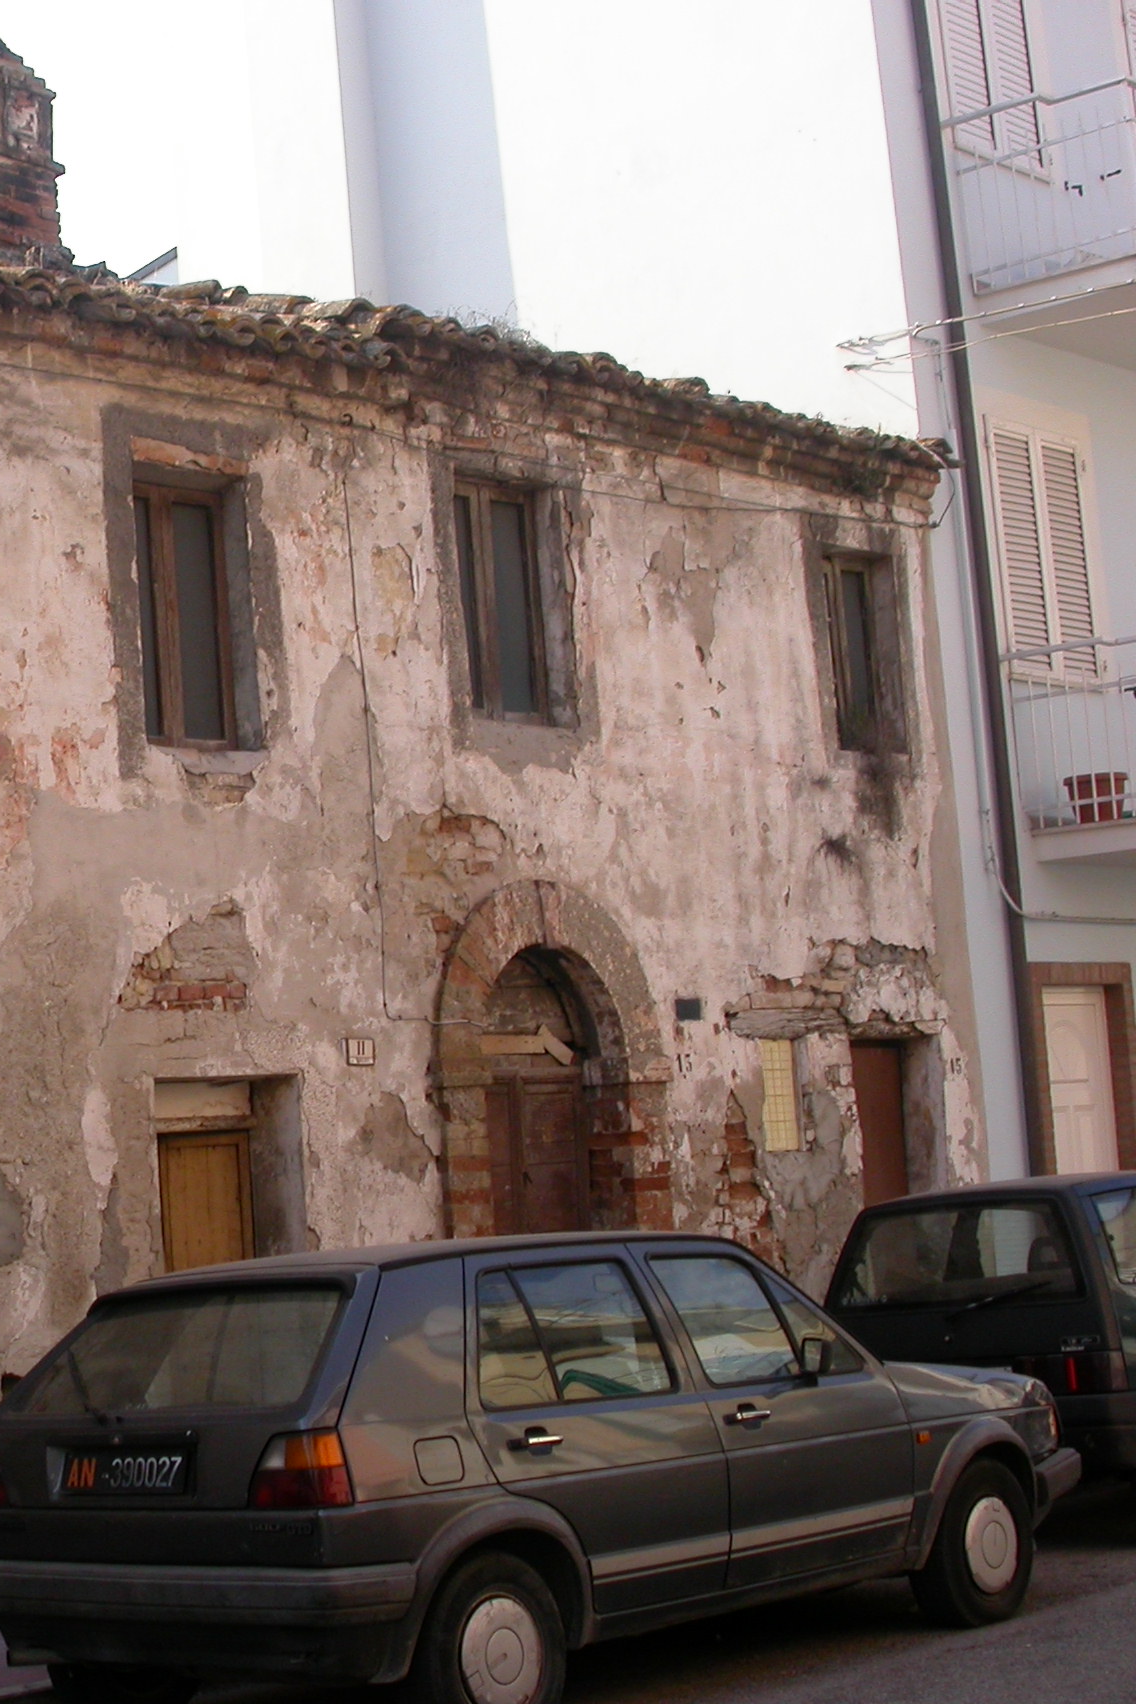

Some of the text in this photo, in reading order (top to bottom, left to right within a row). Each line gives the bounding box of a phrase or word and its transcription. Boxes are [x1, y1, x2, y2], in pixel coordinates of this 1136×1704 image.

[356, 1040, 365, 1055] 11
[949, 1057, 962, 1076] 15
[67, 1456, 183, 1488] AN 390027
